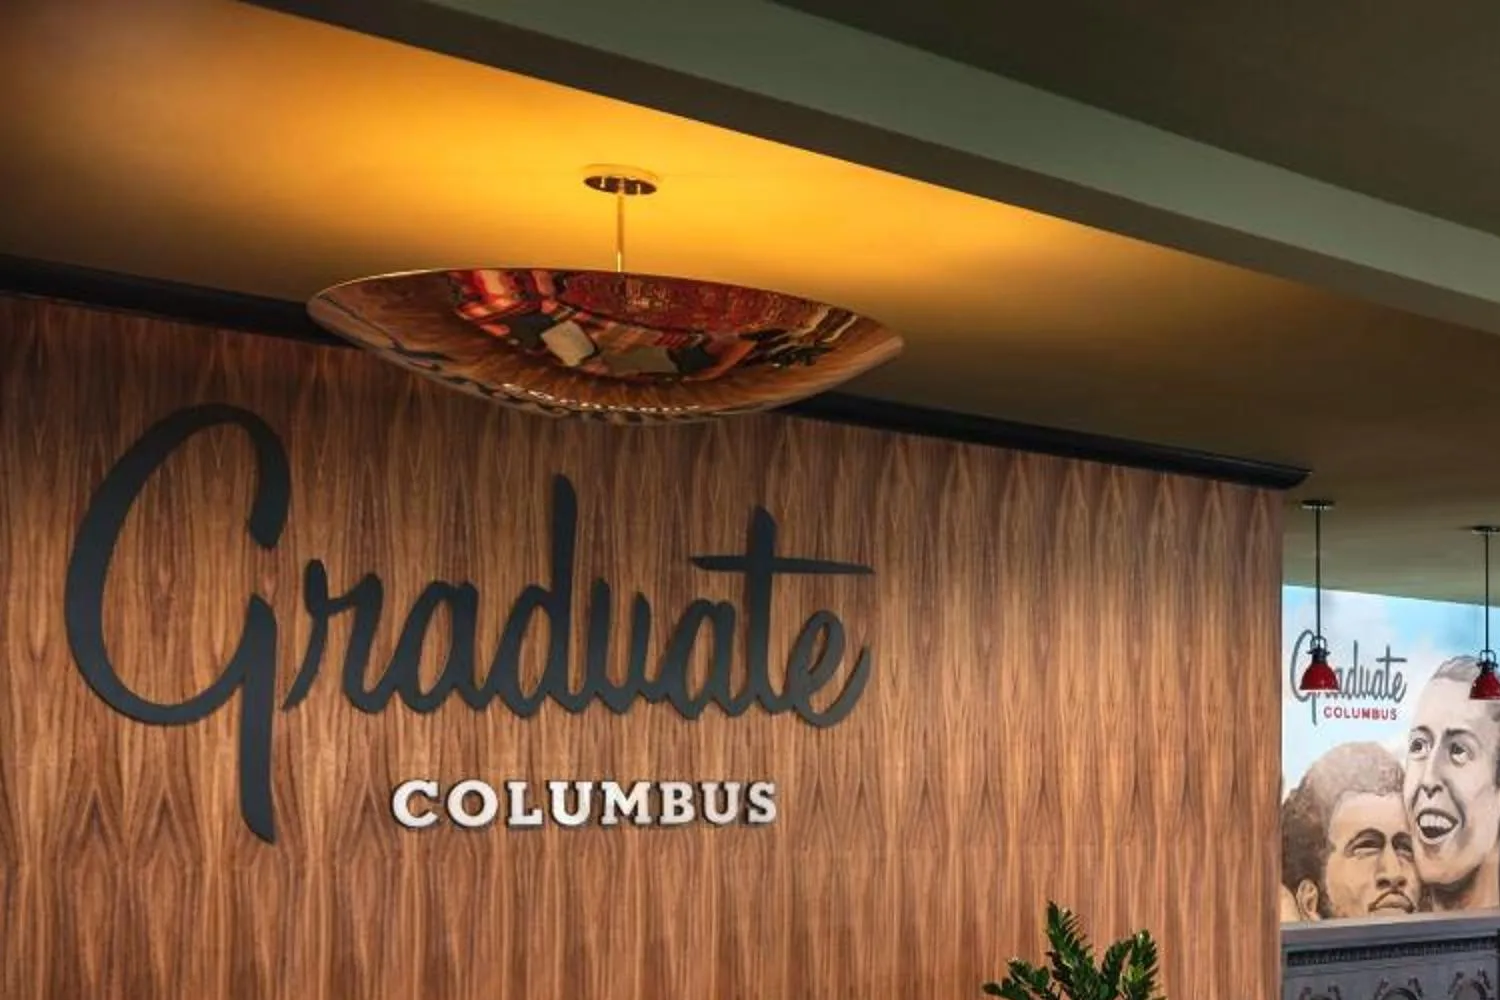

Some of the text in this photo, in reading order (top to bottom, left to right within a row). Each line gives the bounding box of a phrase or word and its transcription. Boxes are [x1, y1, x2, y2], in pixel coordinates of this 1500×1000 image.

[65, 404, 876, 844] Graduate
[1323, 705, 1398, 721] COLUMBUS
[391, 778, 778, 829] COLUMBUS
